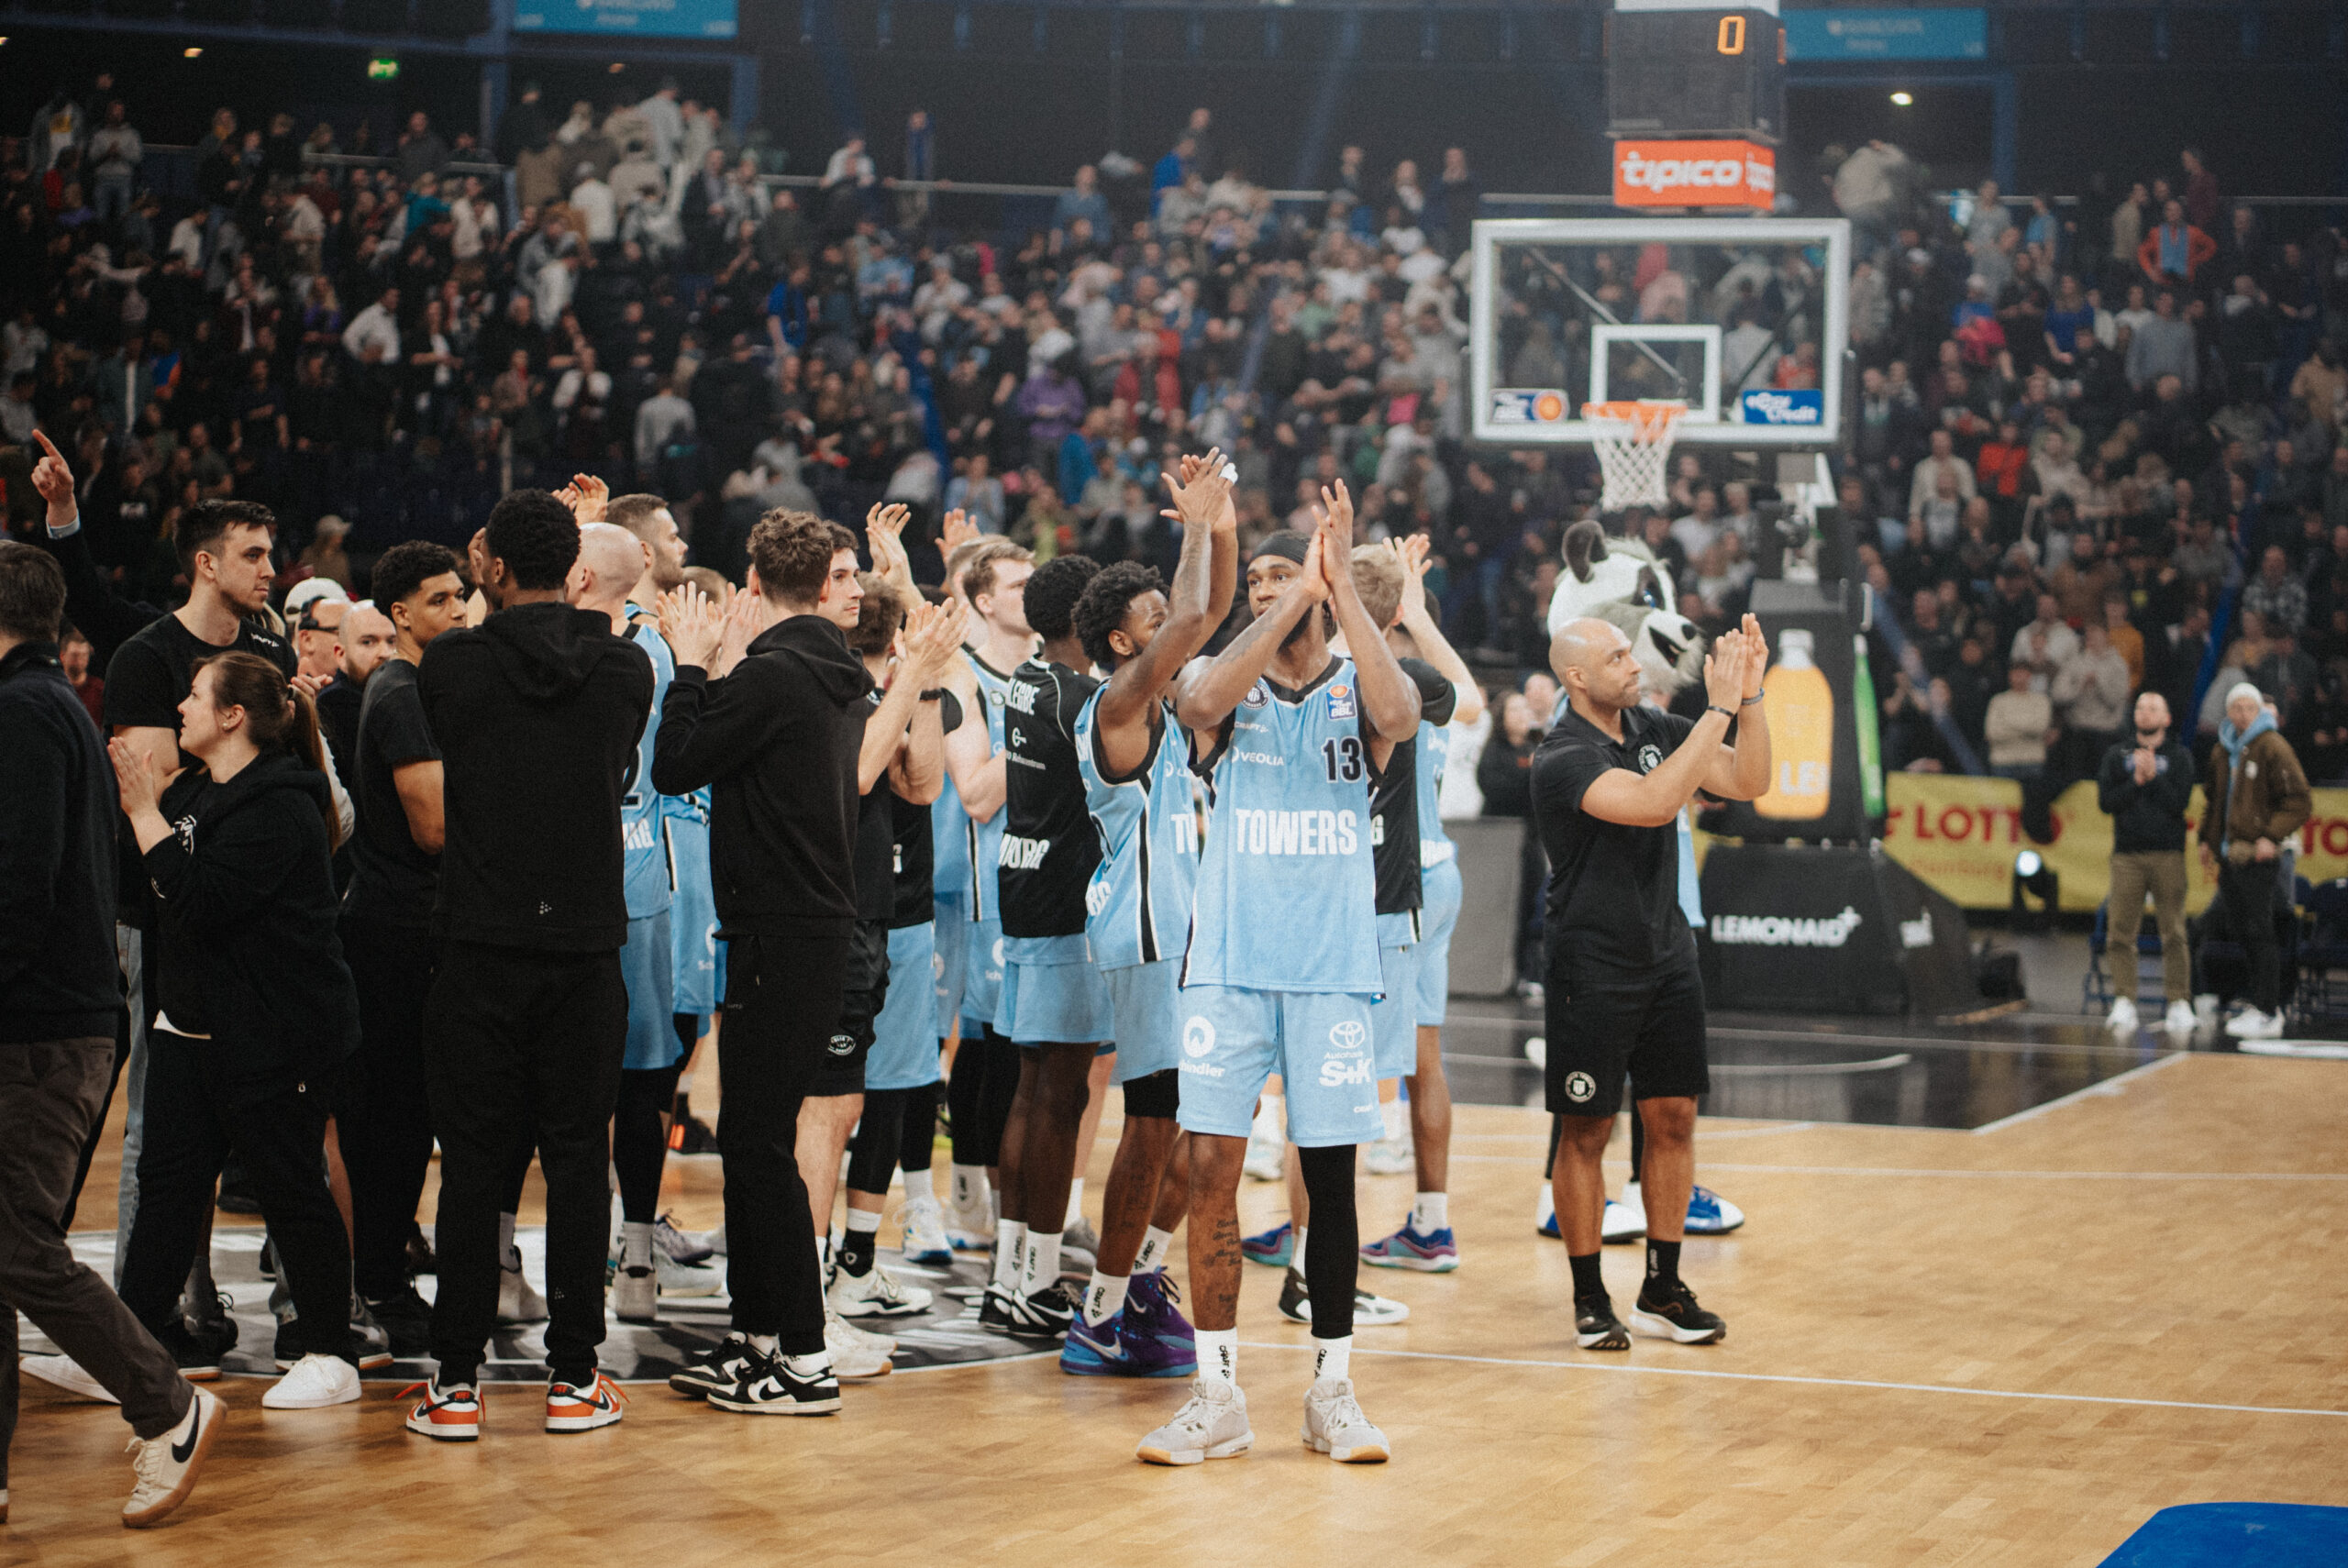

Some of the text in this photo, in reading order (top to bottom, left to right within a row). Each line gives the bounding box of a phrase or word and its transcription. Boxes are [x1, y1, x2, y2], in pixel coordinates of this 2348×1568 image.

[1717, 16, 1746, 55] 0
[1621, 150, 1744, 193] tipico
[1240, 752, 1285, 767] VEOLIA
[1322, 736, 1363, 784] 13
[1235, 808, 1358, 856] TOWERS
[1219, 1345, 1230, 1368] CRAFT
